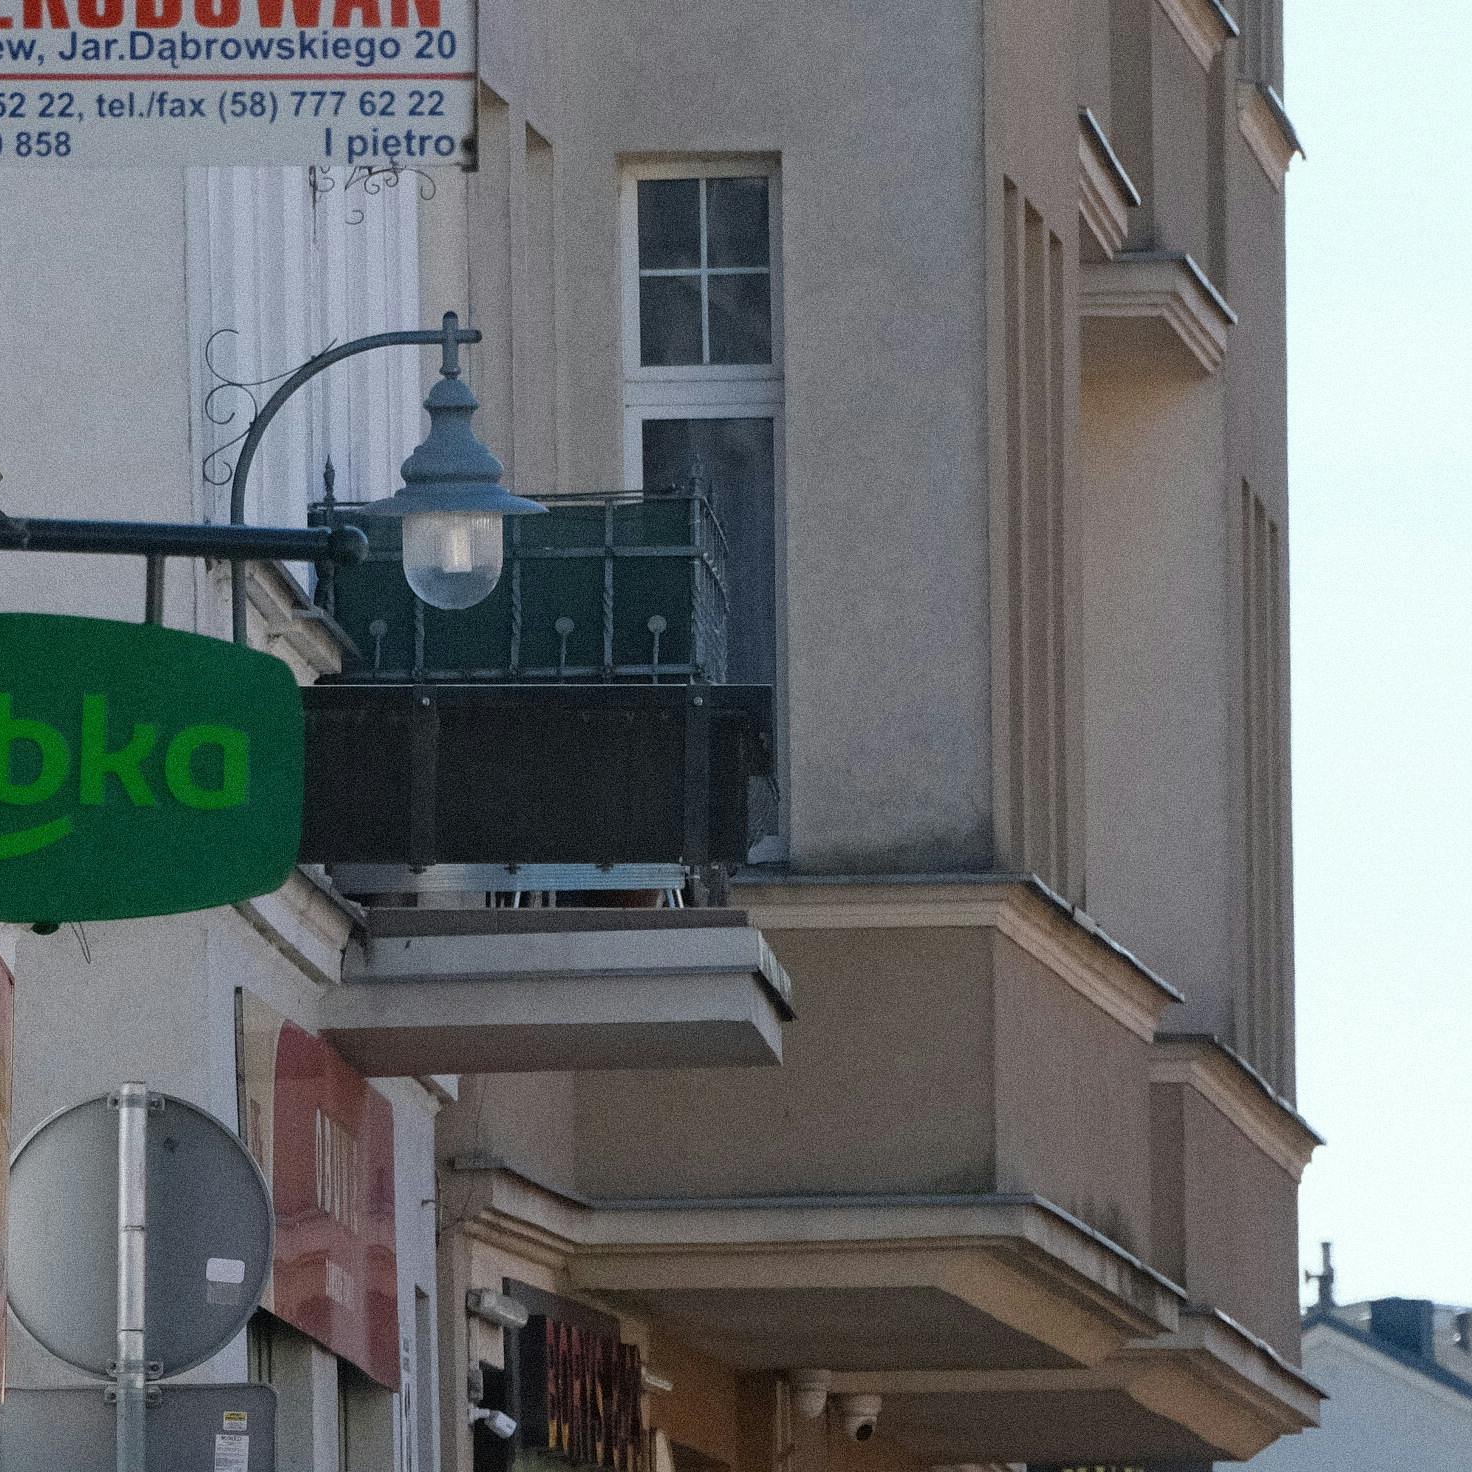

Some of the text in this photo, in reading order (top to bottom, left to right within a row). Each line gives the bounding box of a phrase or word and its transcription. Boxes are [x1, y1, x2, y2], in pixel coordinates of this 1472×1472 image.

[415, 30, 458, 63] 20
[38, 91, 86, 125] 22,
[96, 91, 207, 121] tel./fax
[218, 89, 279, 122] (58)
[291, 89, 349, 119] 777
[359, 89, 399, 119] 62
[407, 89, 447, 119] 22
[16, 130, 73, 160] 858
[346, 127, 457, 167] piętro
